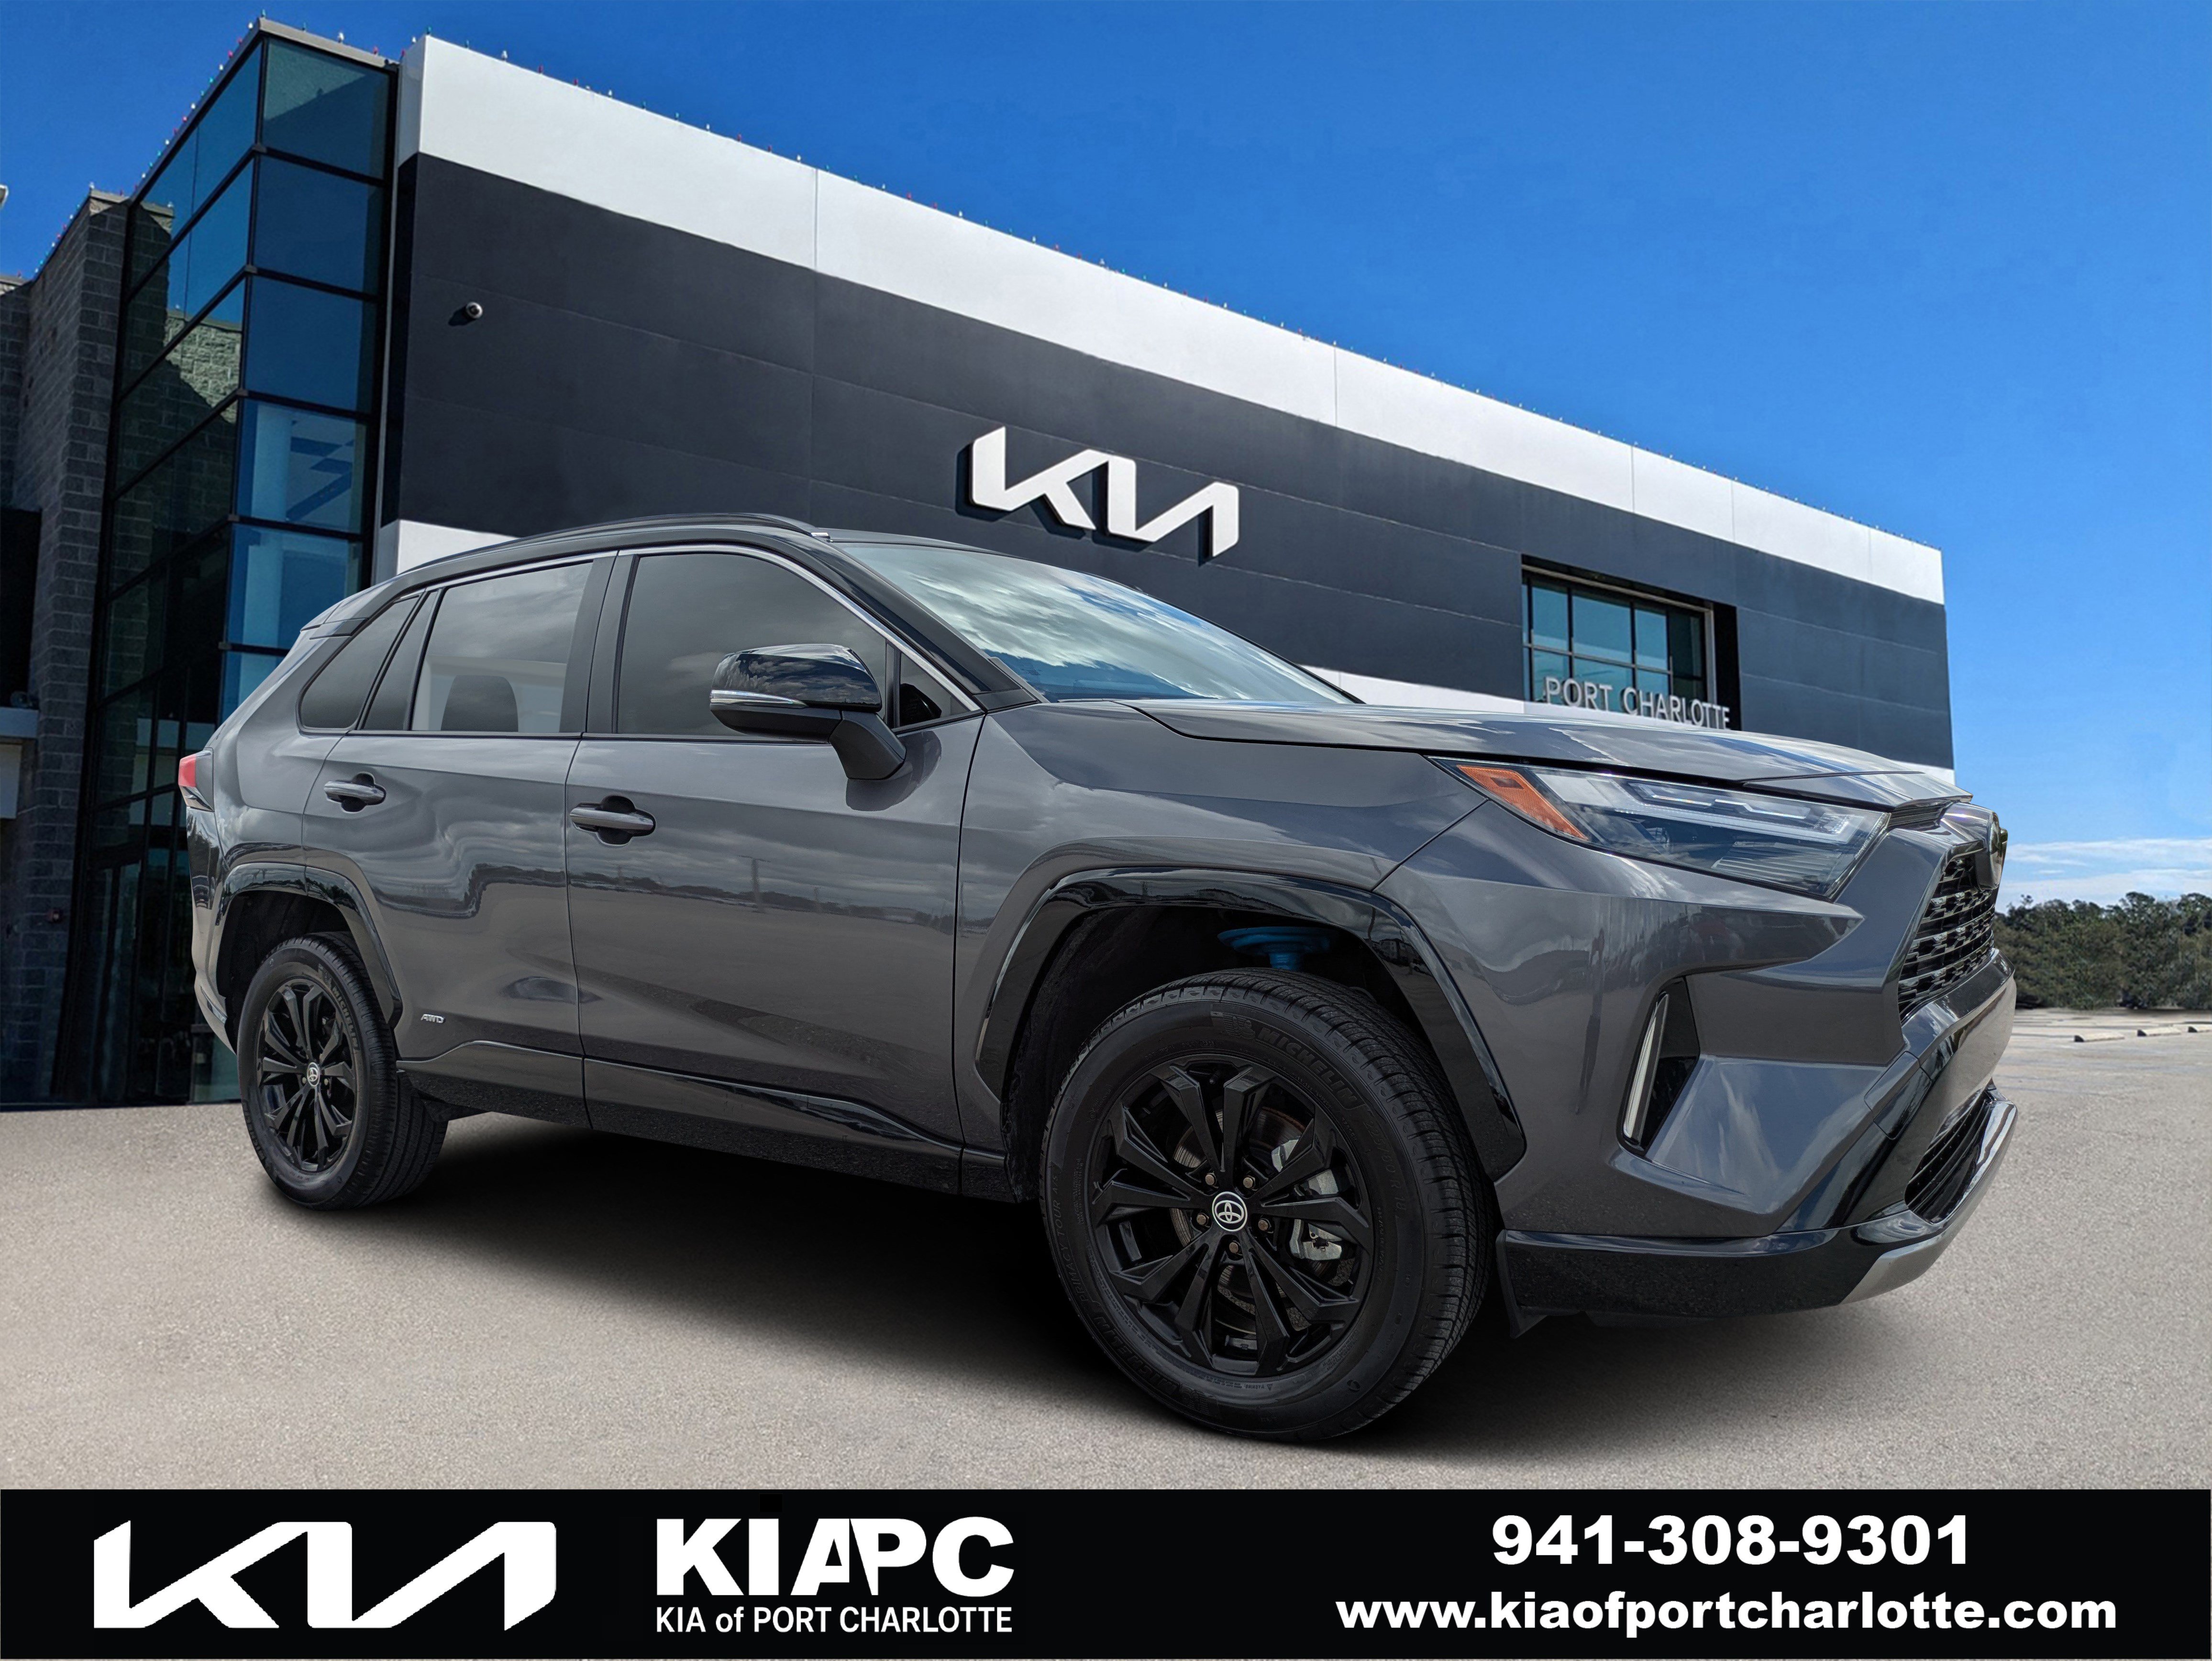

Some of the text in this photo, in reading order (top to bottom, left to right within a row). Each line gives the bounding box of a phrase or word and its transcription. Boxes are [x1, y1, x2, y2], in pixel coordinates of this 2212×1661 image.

[1546, 676, 1730, 731] PORT CHARLOTTE
[332, 986, 359, 1048] MICHELIN
[420, 1014, 445, 1024] AWD
[1257, 1028, 1358, 1101] MICHELIN
[1053, 1200, 1065, 1236] TOUR
[1061, 1246, 1090, 1303] PRIMACY
